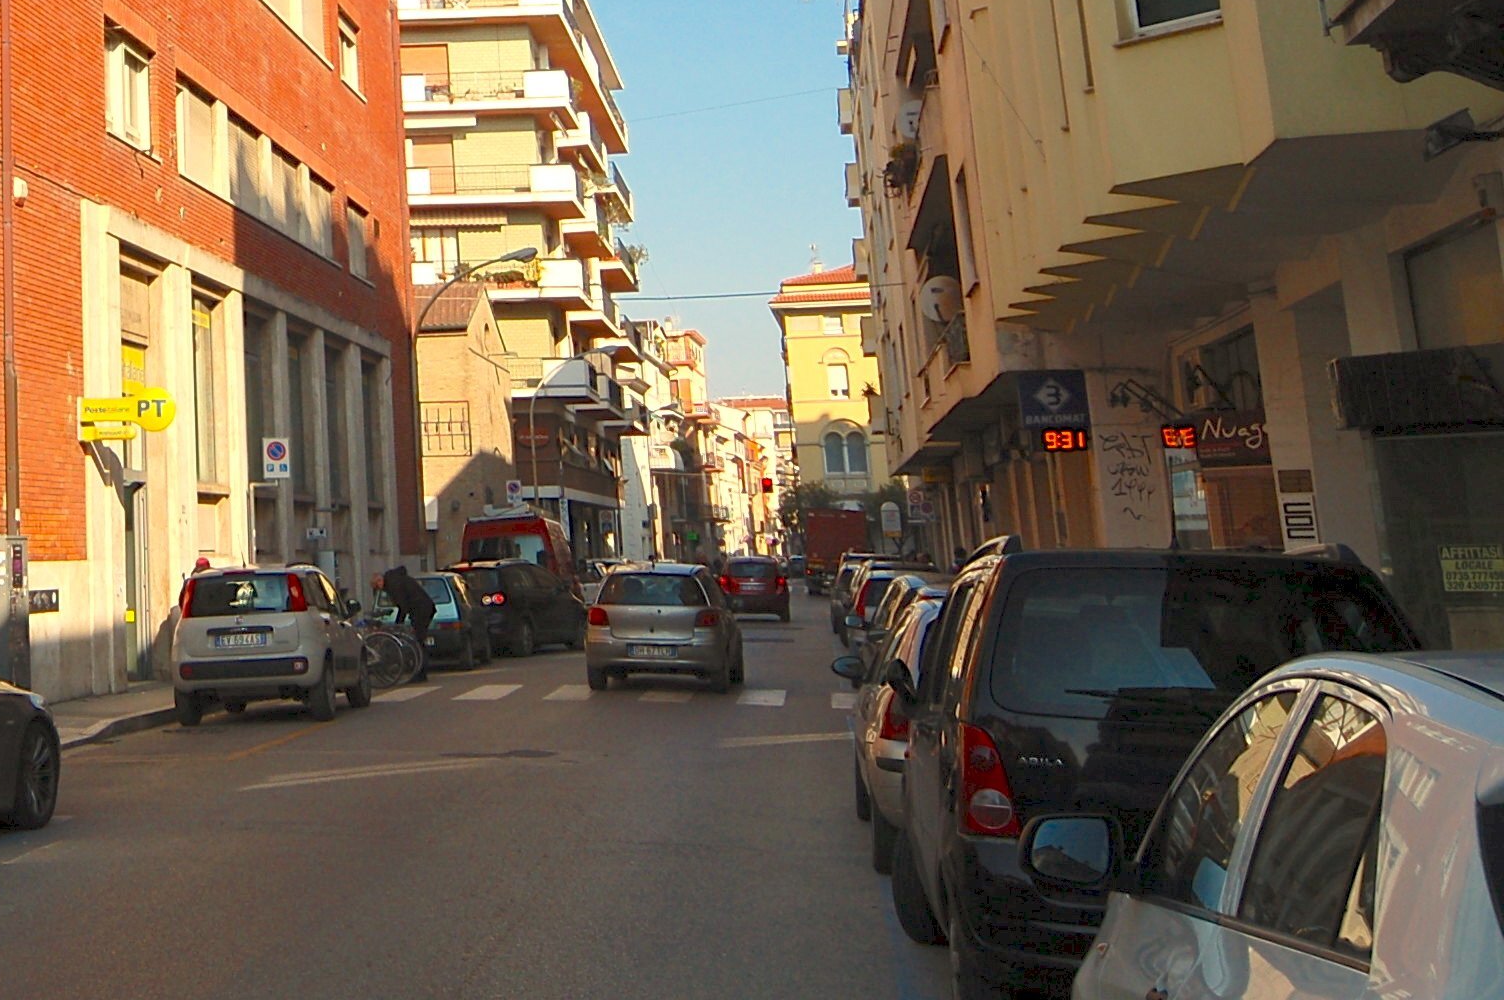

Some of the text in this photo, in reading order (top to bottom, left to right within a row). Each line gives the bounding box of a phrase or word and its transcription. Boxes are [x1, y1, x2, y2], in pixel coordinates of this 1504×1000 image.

[137, 399, 167, 418] PT
[1025, 413, 1086, 425] BANCOMAT
[1045, 431, 1084, 449] 9:31
[1456, 560, 1494, 570] LOCALE
